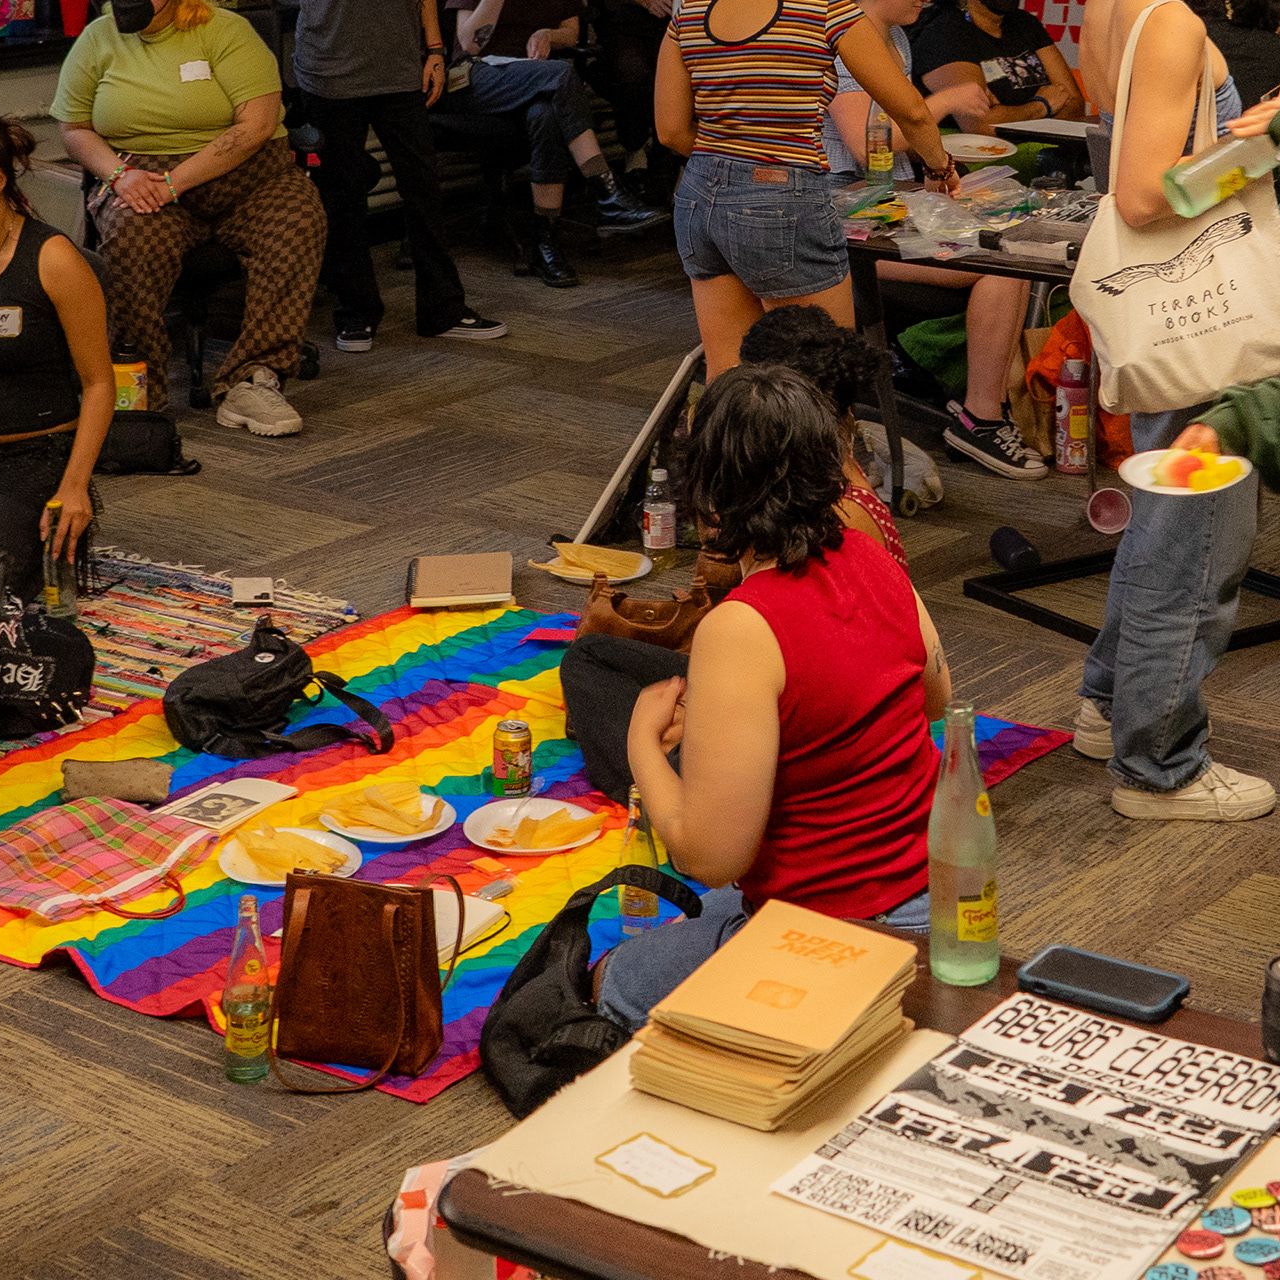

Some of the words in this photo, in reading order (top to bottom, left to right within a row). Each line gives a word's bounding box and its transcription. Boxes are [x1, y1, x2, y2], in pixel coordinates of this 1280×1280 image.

[1148, 279, 1239, 316] TERRACE
[1165, 299, 1231, 330] BOOKS
[1152, 334, 1184, 347] WINDSOR
[770, 943, 854, 970] MFA
[780, 927, 871, 956] OPEN
[982, 1006, 1111, 1061] ABSURD
[1036, 1054, 1059, 1066] BY
[797, 1177, 894, 1218] CERTIFICATE
[806, 1171, 903, 1210] ALTERNATIVE
[835, 1169, 875, 1189] EARN
[878, 1183, 916, 1202] YOUR
[788, 1184, 802, 1196] IN
[806, 1192, 857, 1214] STUDIO
[858, 1209, 891, 1225] ART
